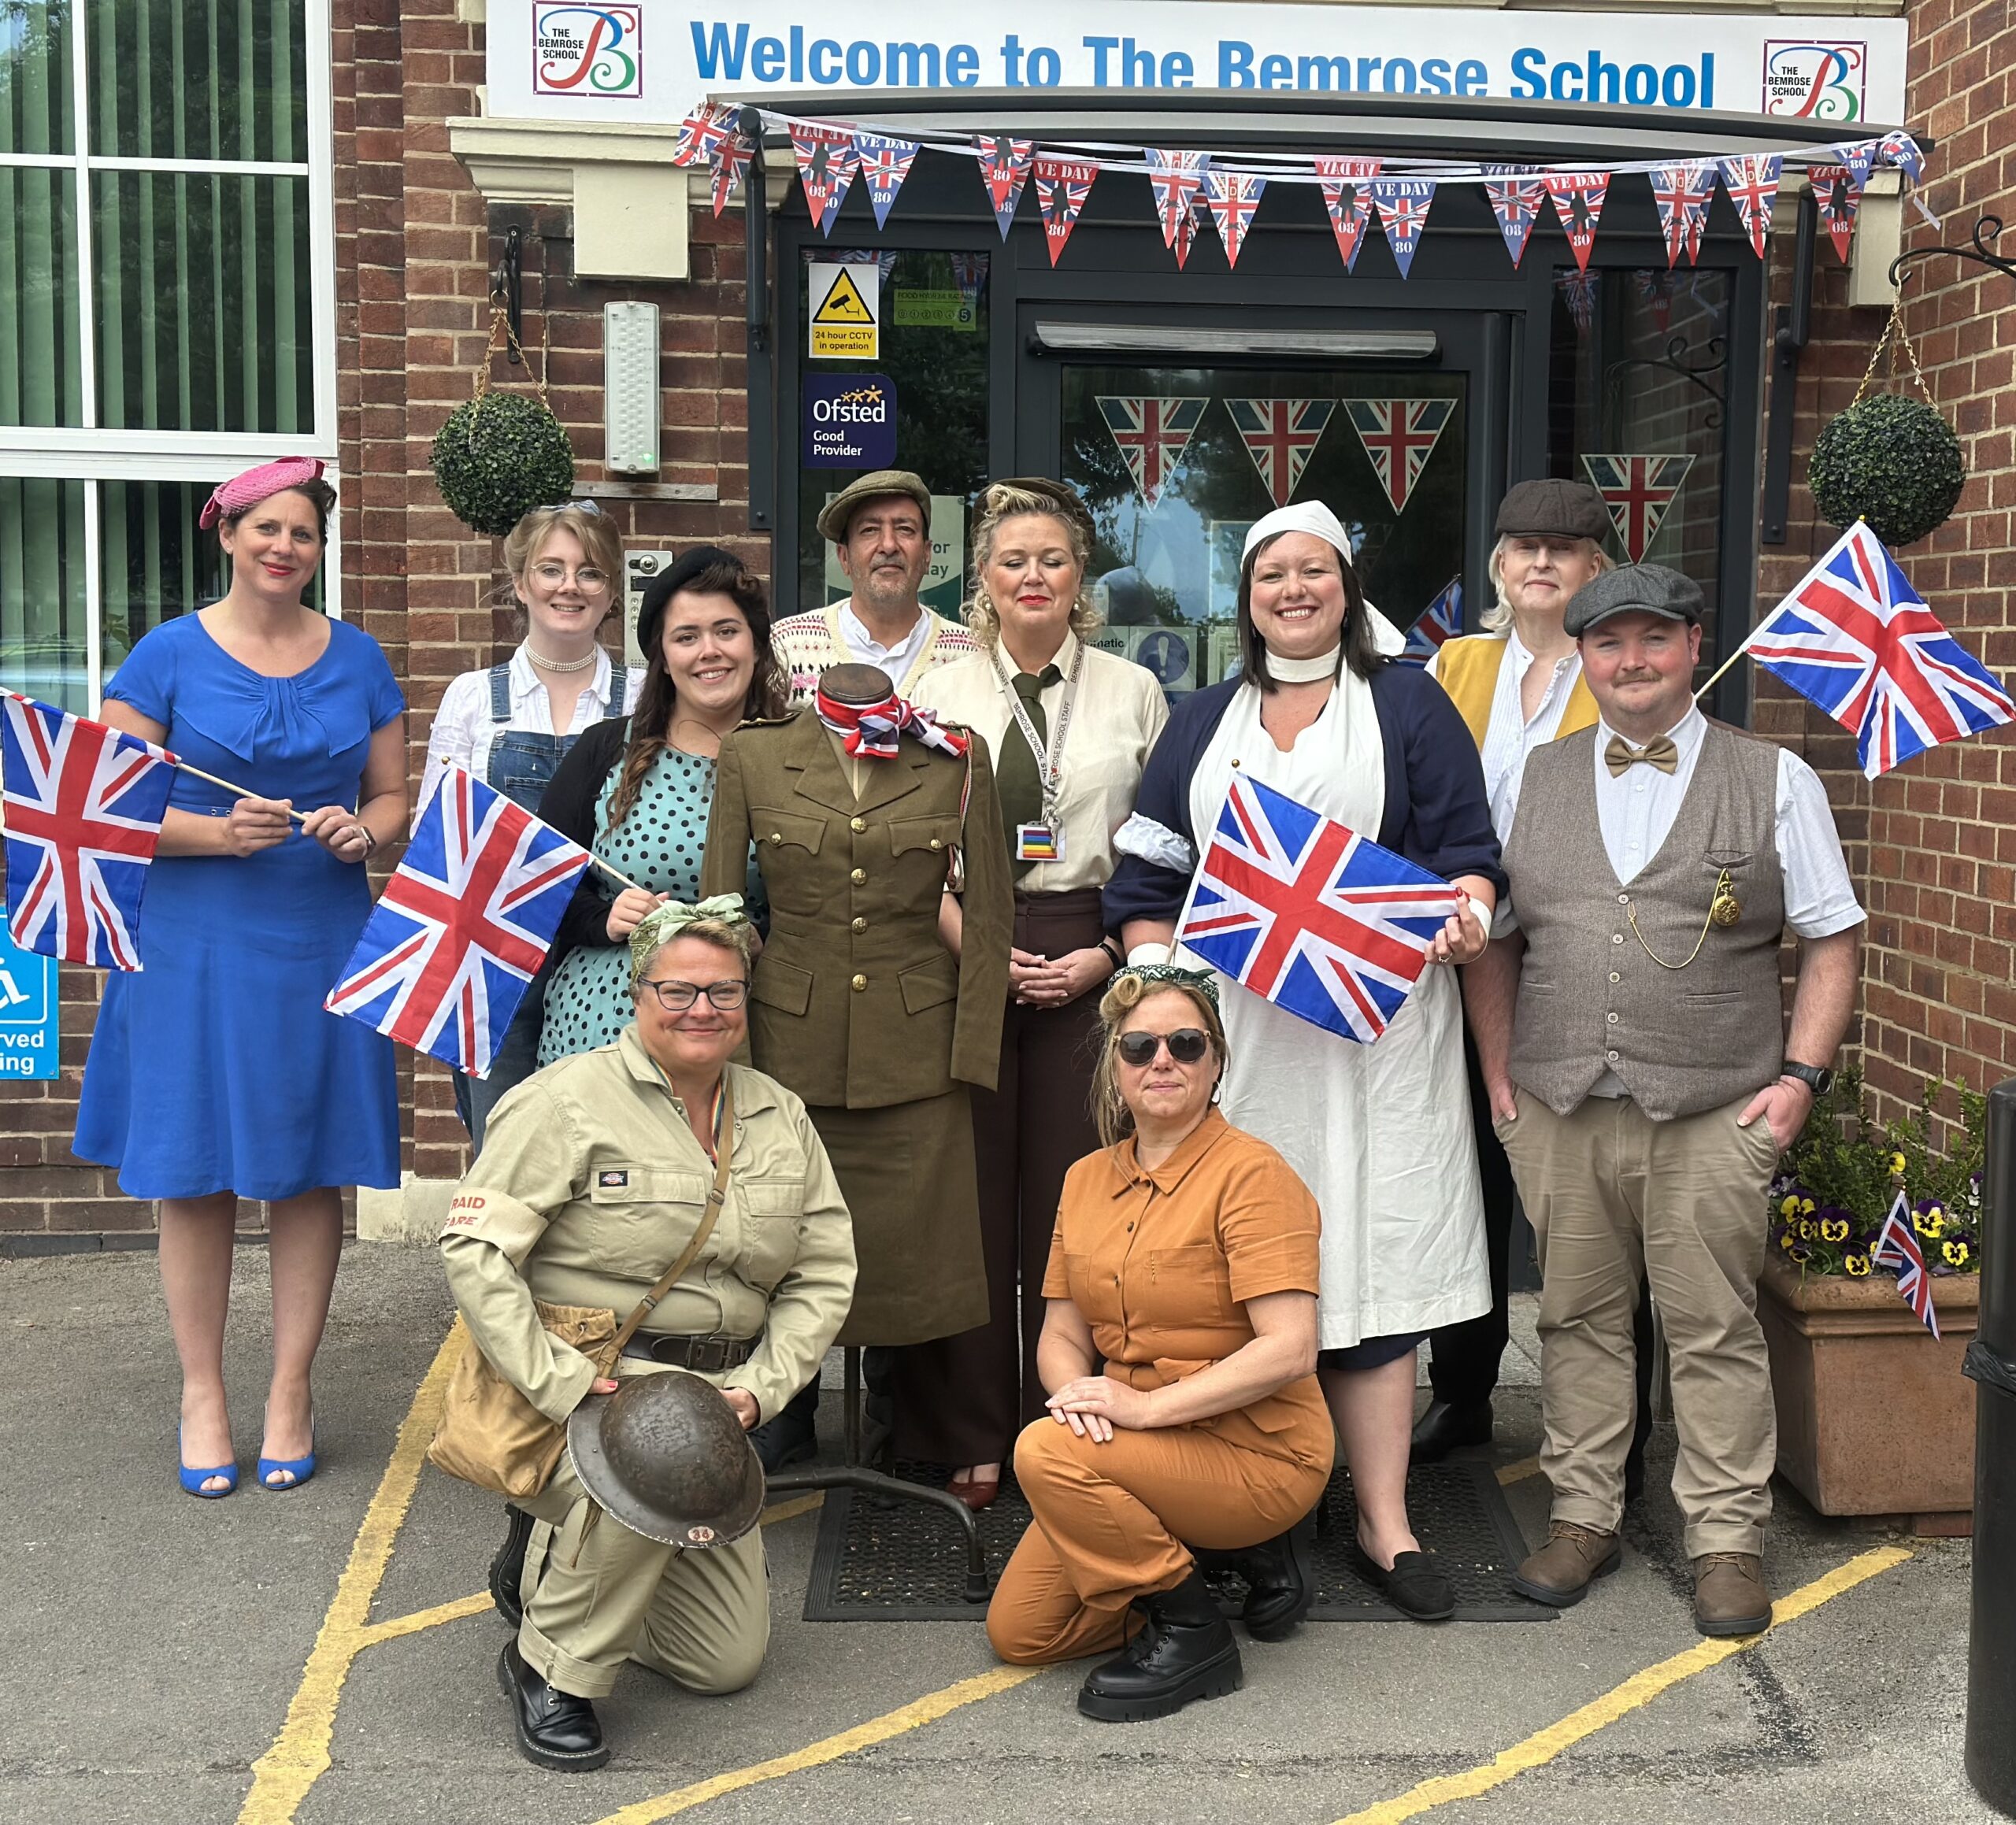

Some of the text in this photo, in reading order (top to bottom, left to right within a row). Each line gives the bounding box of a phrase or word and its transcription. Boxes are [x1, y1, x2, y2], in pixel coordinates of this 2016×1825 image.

[552, 28, 569, 38] THE
[539, 39, 584, 49] BEMROSE
[543, 50, 580, 59] SCHOOL
[690, 21, 1714, 109] Welcome to The Bemrose School
[1781, 66, 1798, 75] THE
[1768, 77, 1811, 86] BEMROSE
[1772, 87, 1807, 96] SCHOOL
[859, 135, 916, 150] VE DAY
[1850, 159, 1868, 169] 80
[1894, 152, 1912, 165] 80
[992, 169, 1010, 182] 80
[1036, 162, 1092, 181] VE DAY
[1550, 173, 1605, 190] VE DAY
[1375, 183, 1431, 196] VE DAY
[873, 191, 891, 203] 80
[1048, 224, 1065, 236] 80
[1573, 235, 1590, 246] 80
[1395, 241, 1413, 254] 80
[962, 309, 969, 321] 5
[813, 398, 885, 422] Ofsted
[813, 430, 844, 441] Good
[813, 444, 862, 456] Provider
[931, 541, 951, 553] or
[928, 565, 949, 578] ay
[1086, 639, 1125, 648] matic
[1071, 653, 1083, 683] BEMROSE
[1013, 702, 1032, 733] BEMROSE
[1028, 731, 1044, 761] SCHOOL
[1055, 724, 1066, 750] SCHOOL
[1062, 701, 1071, 722] STAFF
[451, 1197, 486, 1210] RAID
